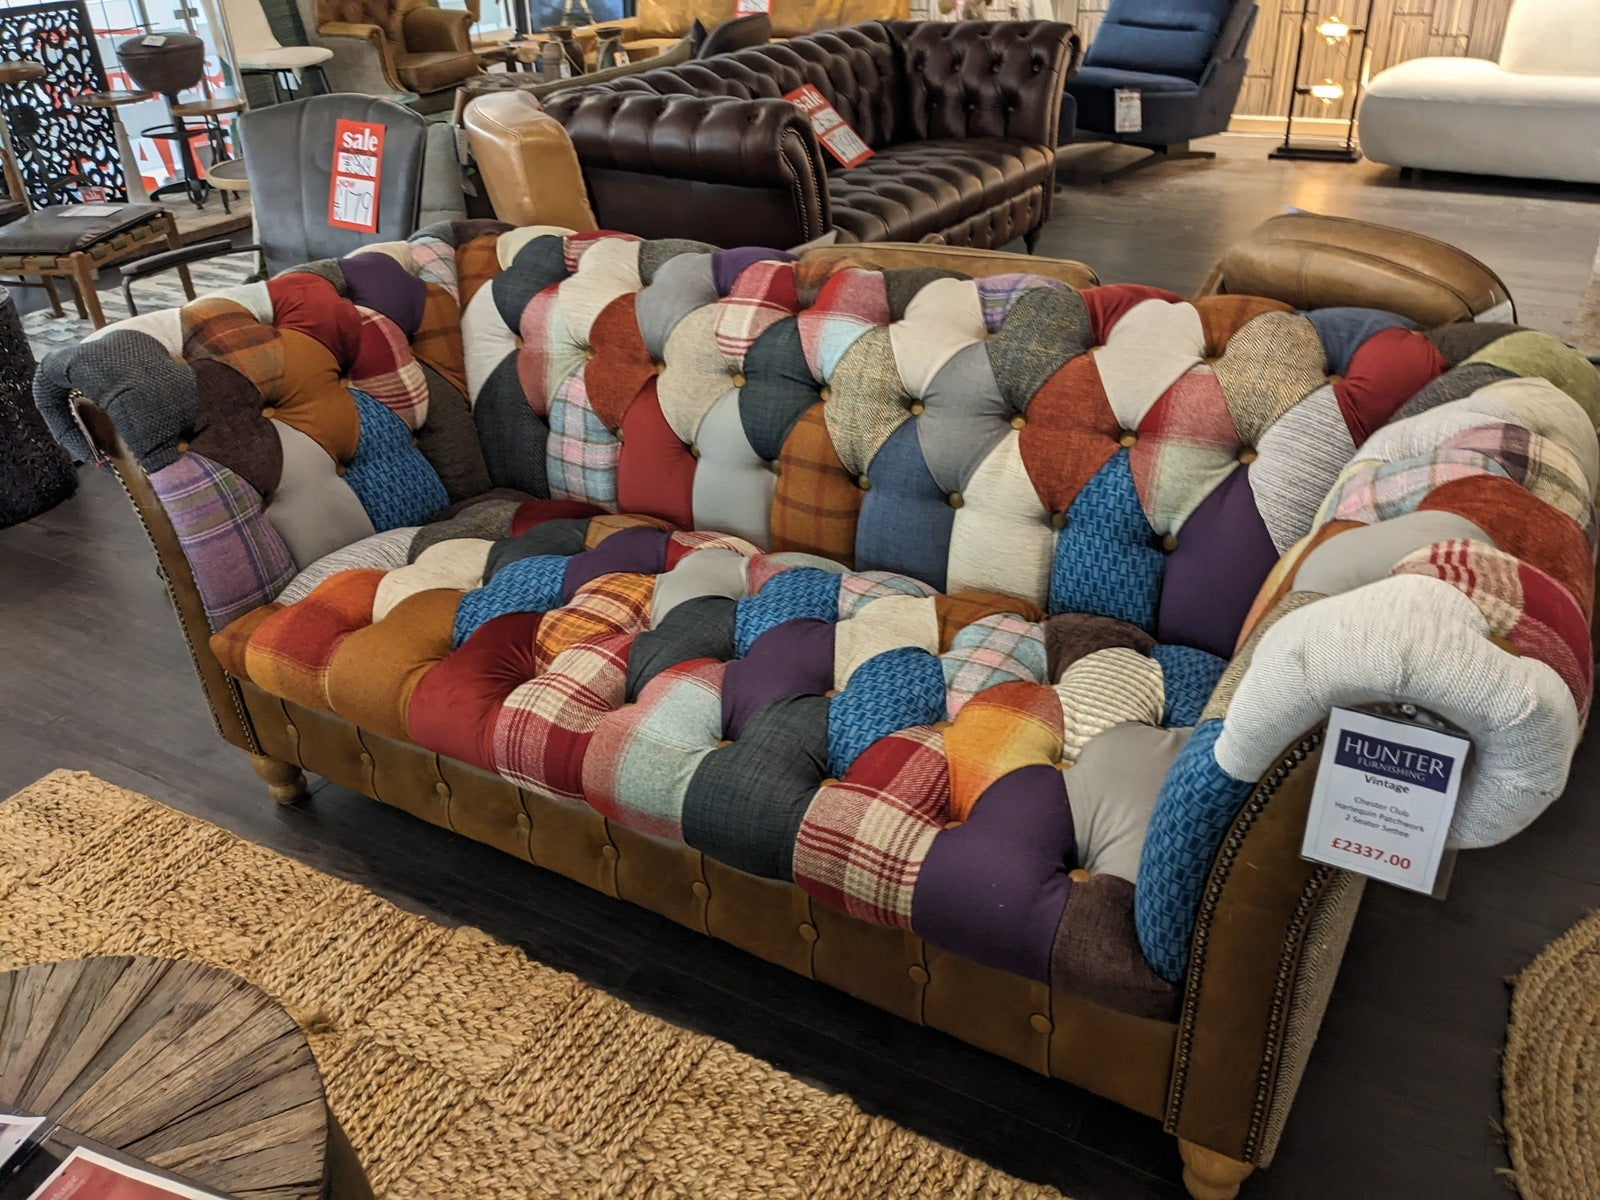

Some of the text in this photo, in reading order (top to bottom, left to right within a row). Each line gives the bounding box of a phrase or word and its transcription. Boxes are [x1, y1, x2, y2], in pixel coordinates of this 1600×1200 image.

[792, 88, 824, 112] sale
[342, 128, 378, 152] sale
[1344, 736, 1445, 778] HUNTER
[1357, 756, 1426, 781] FURNISHING
[1365, 774, 1409, 794] Vintage
[1334, 801, 1425, 833] Harlequin Patchwork
[1354, 796, 1409, 818] Chester Club
[1344, 814, 1410, 839] 2 Seater Settee
[1331, 837, 1411, 870] £2337.00
